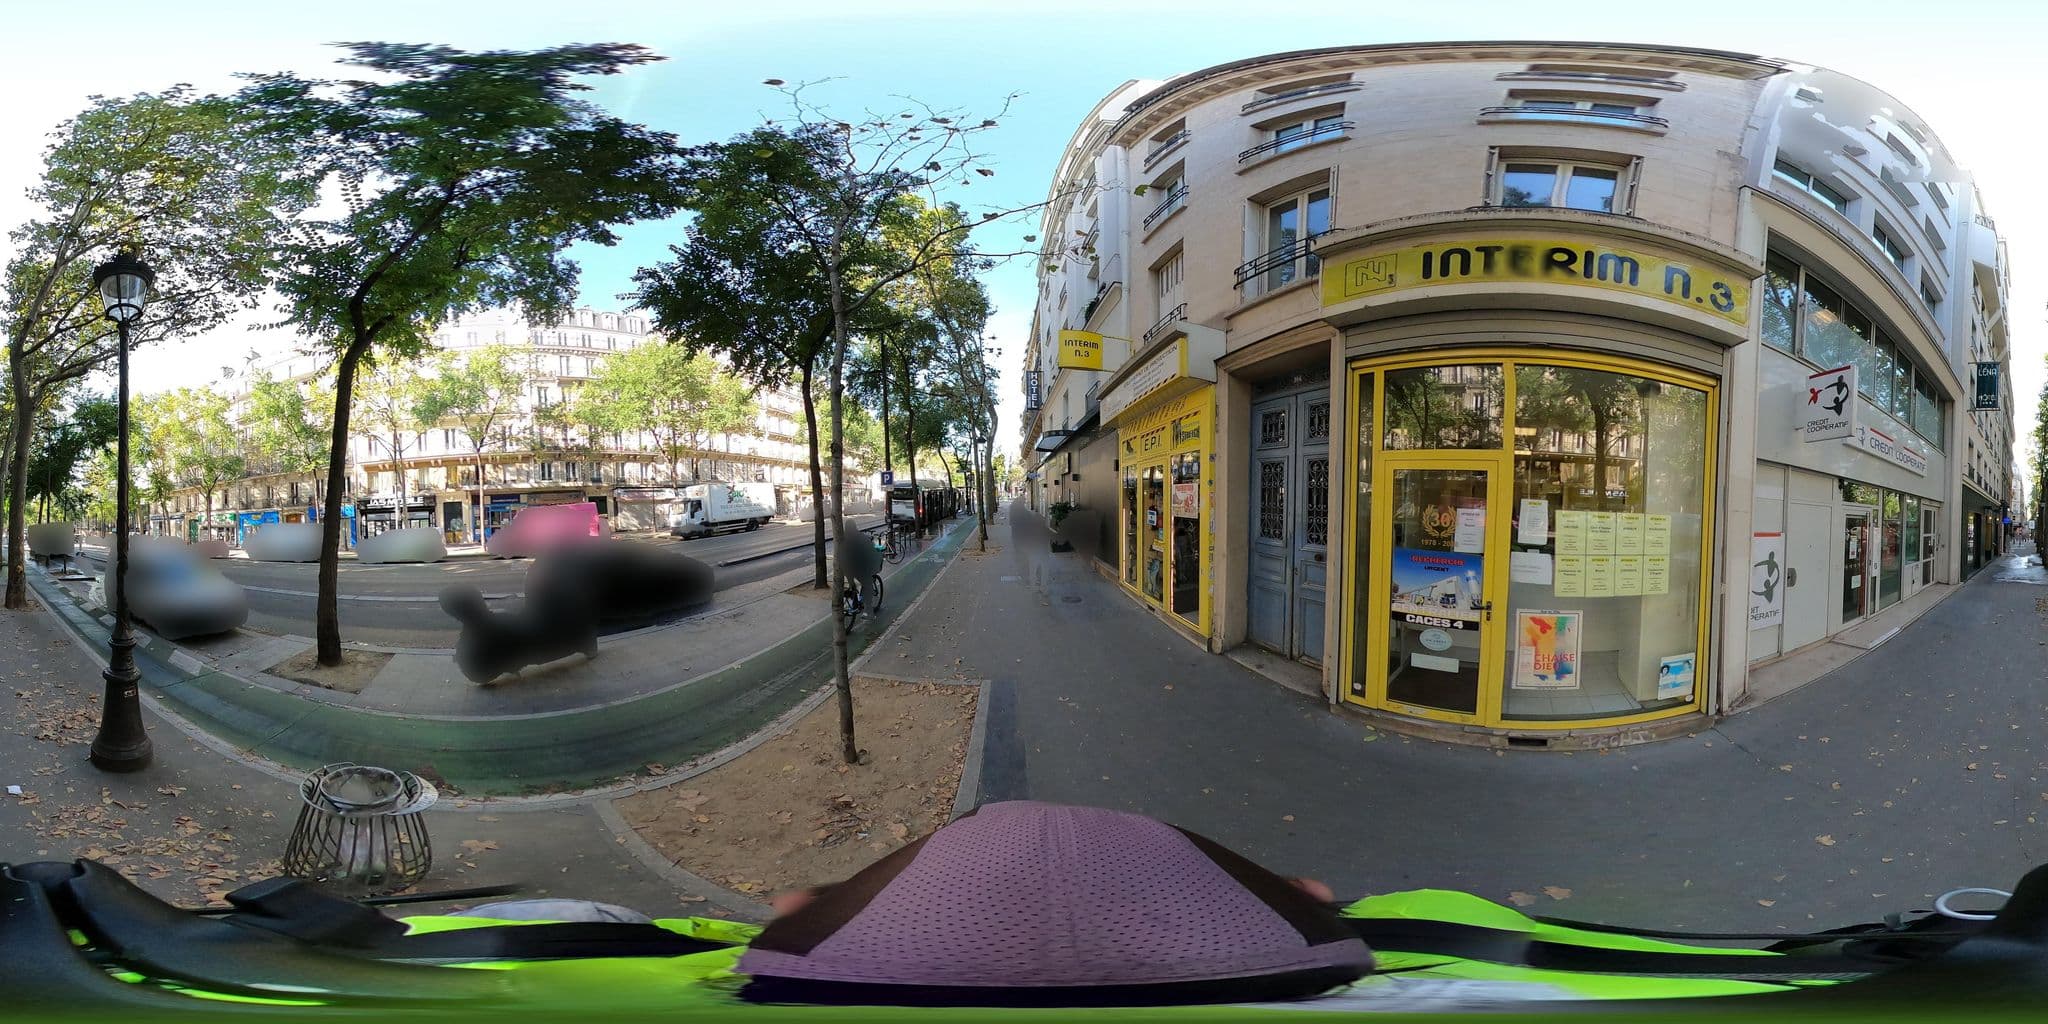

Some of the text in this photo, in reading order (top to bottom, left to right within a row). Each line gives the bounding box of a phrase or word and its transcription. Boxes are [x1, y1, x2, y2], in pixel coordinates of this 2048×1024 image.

[1030, 372, 1038, 408] HOTEL
[884, 474, 890, 484] P
[1406, 614, 1464, 629] CACES 4
[1534, 653, 1576, 662] CHAISE
